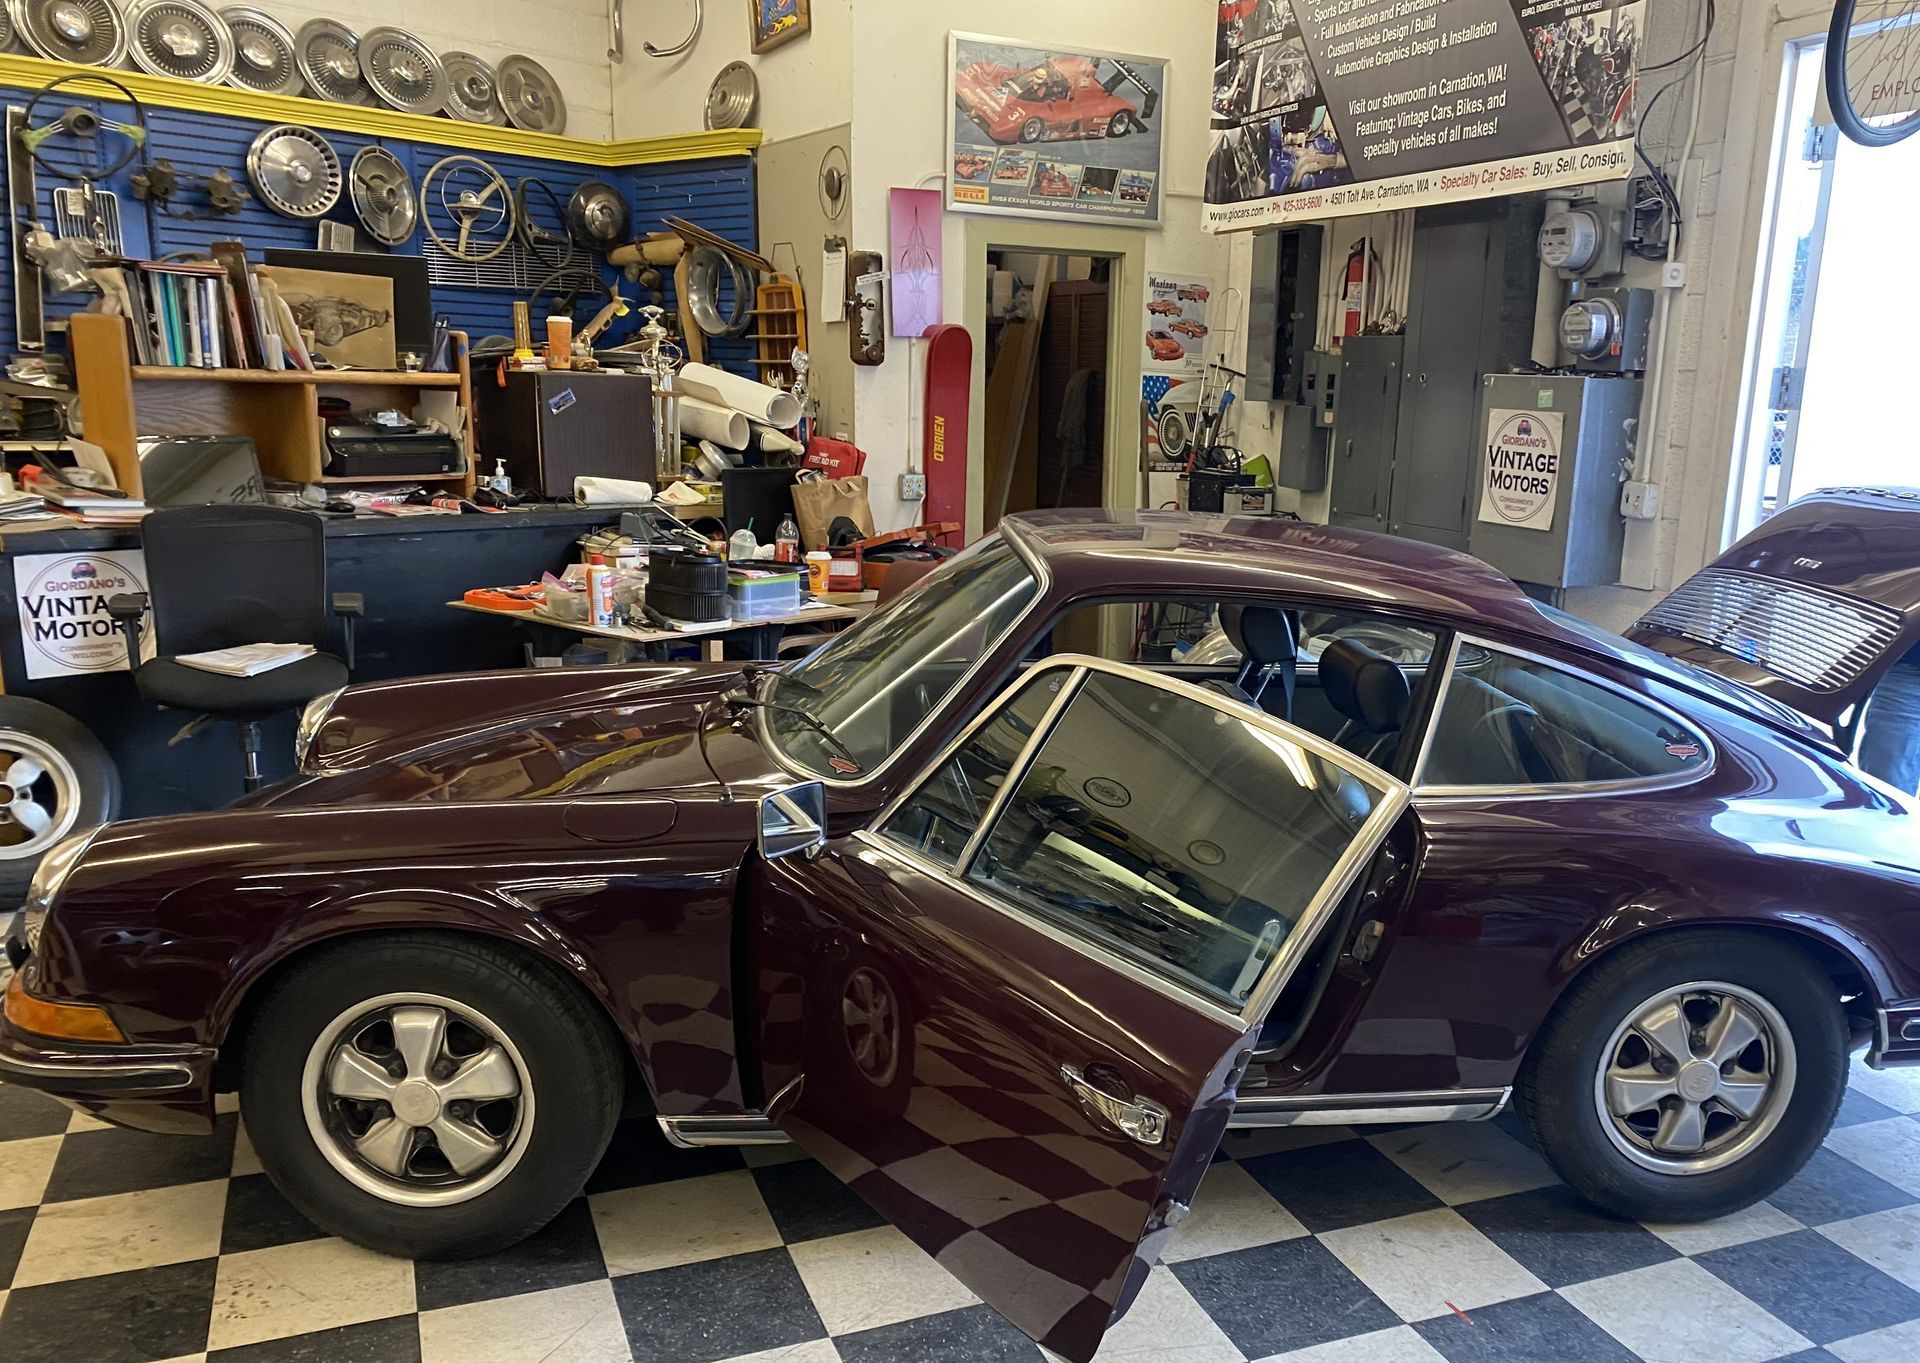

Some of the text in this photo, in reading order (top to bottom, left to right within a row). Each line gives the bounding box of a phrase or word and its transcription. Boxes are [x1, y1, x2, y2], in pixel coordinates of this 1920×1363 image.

[1314, 7, 1337, 24] Sports
[1338, 0, 1351, 15] Car
[1319, 0, 1442, 41] Full Modification and Fabrication
[1565, 5, 1581, 16] MANY
[1327, 40, 1354, 59] Custom
[1355, 32, 1381, 51] Vehicle
[1382, 23, 1409, 44] Design
[1415, 14, 1437, 34] Build
[1334, 21, 1498, 77] Automotive Graphics Design & Installation
[1349, 63, 1508, 116] Visit our showroom in Carnation, WA!
[1355, 90, 1507, 137] Featuring: Vintage Cars, Bikes, and
[1363, 117, 1498, 161] specialty vehicles of all makes!
[1272, 201, 1282, 214] Ph.
[1283, 195, 1323, 212] 425-333-5600
[1330, 192, 1346, 205] 4501
[1347, 189, 1359, 203] Tolt
[1360, 187, 1376, 202] Ave.
[1377, 182, 1415, 199] Carnation,
[1416, 178, 1429, 193] WA
[1440, 169, 1480, 192] Specialty
[1481, 168, 1497, 184] Car
[1499, 165, 1528, 181] Sales:
[1532, 161, 1554, 179] Buy,
[1556, 156, 1578, 174] Sell,
[1580, 150, 1626, 170] Consign.
[1008, 196, 1029, 204] EXXON
[1029, 198, 1050, 206] WORLD
[1051, 200, 1075, 208] SPORTS
[1502, 434, 1547, 449] GIORDANO'S
[808, 455, 820, 464] FIRST
[821, 458, 829, 466] AID
[829, 460, 840, 468] KIT
[1488, 445, 1558, 474] VINTAGE
[1489, 469, 1550, 495] MOTORS
[45, 577, 126, 592] GIORDANO'S
[21, 592, 150, 618] VINTA
